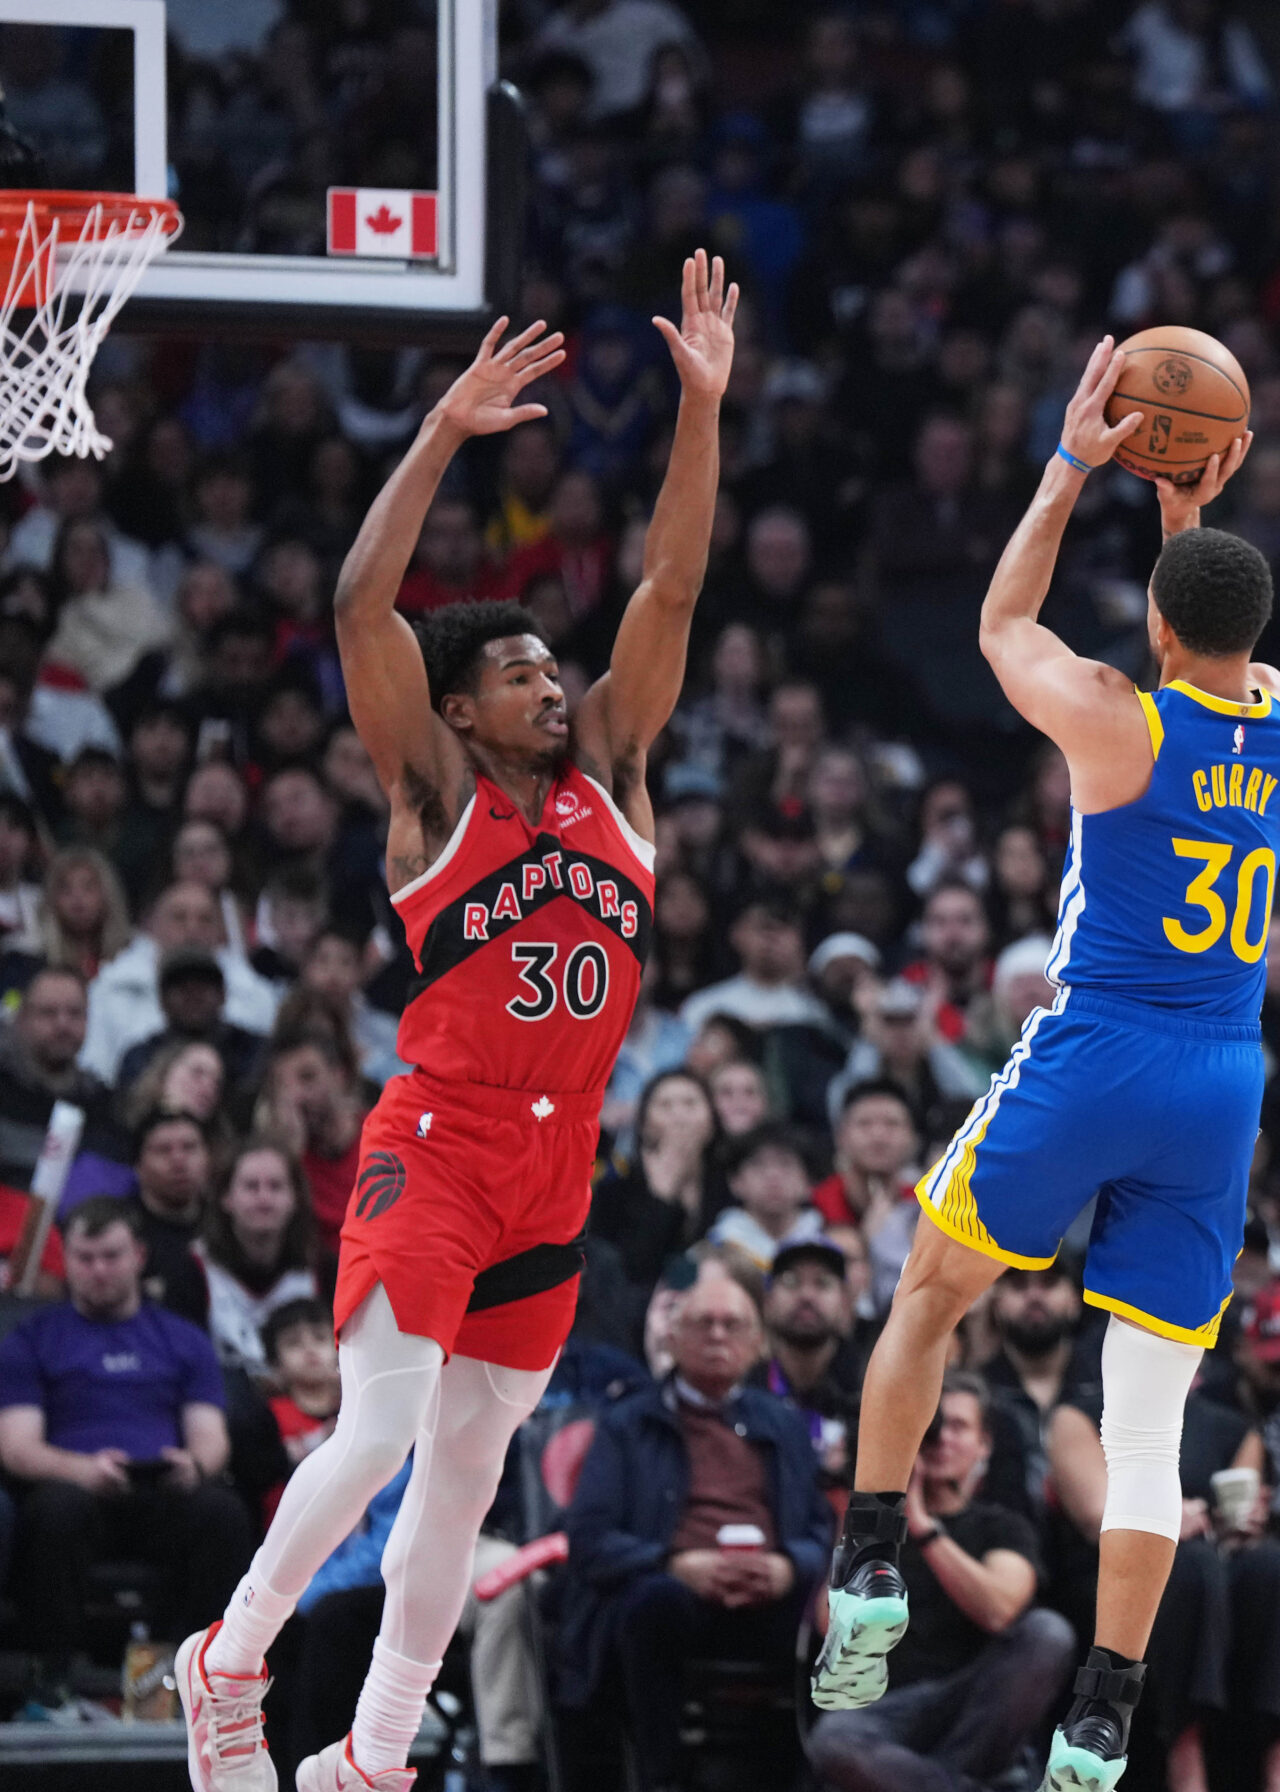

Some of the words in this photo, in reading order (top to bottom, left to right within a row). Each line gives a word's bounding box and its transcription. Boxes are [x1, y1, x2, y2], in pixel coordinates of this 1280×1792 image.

[1192, 763, 1278, 816] CURRY
[463, 851, 638, 940] RAPTORS
[1162, 837, 1276, 964] 30
[505, 941, 609, 1022] 30
